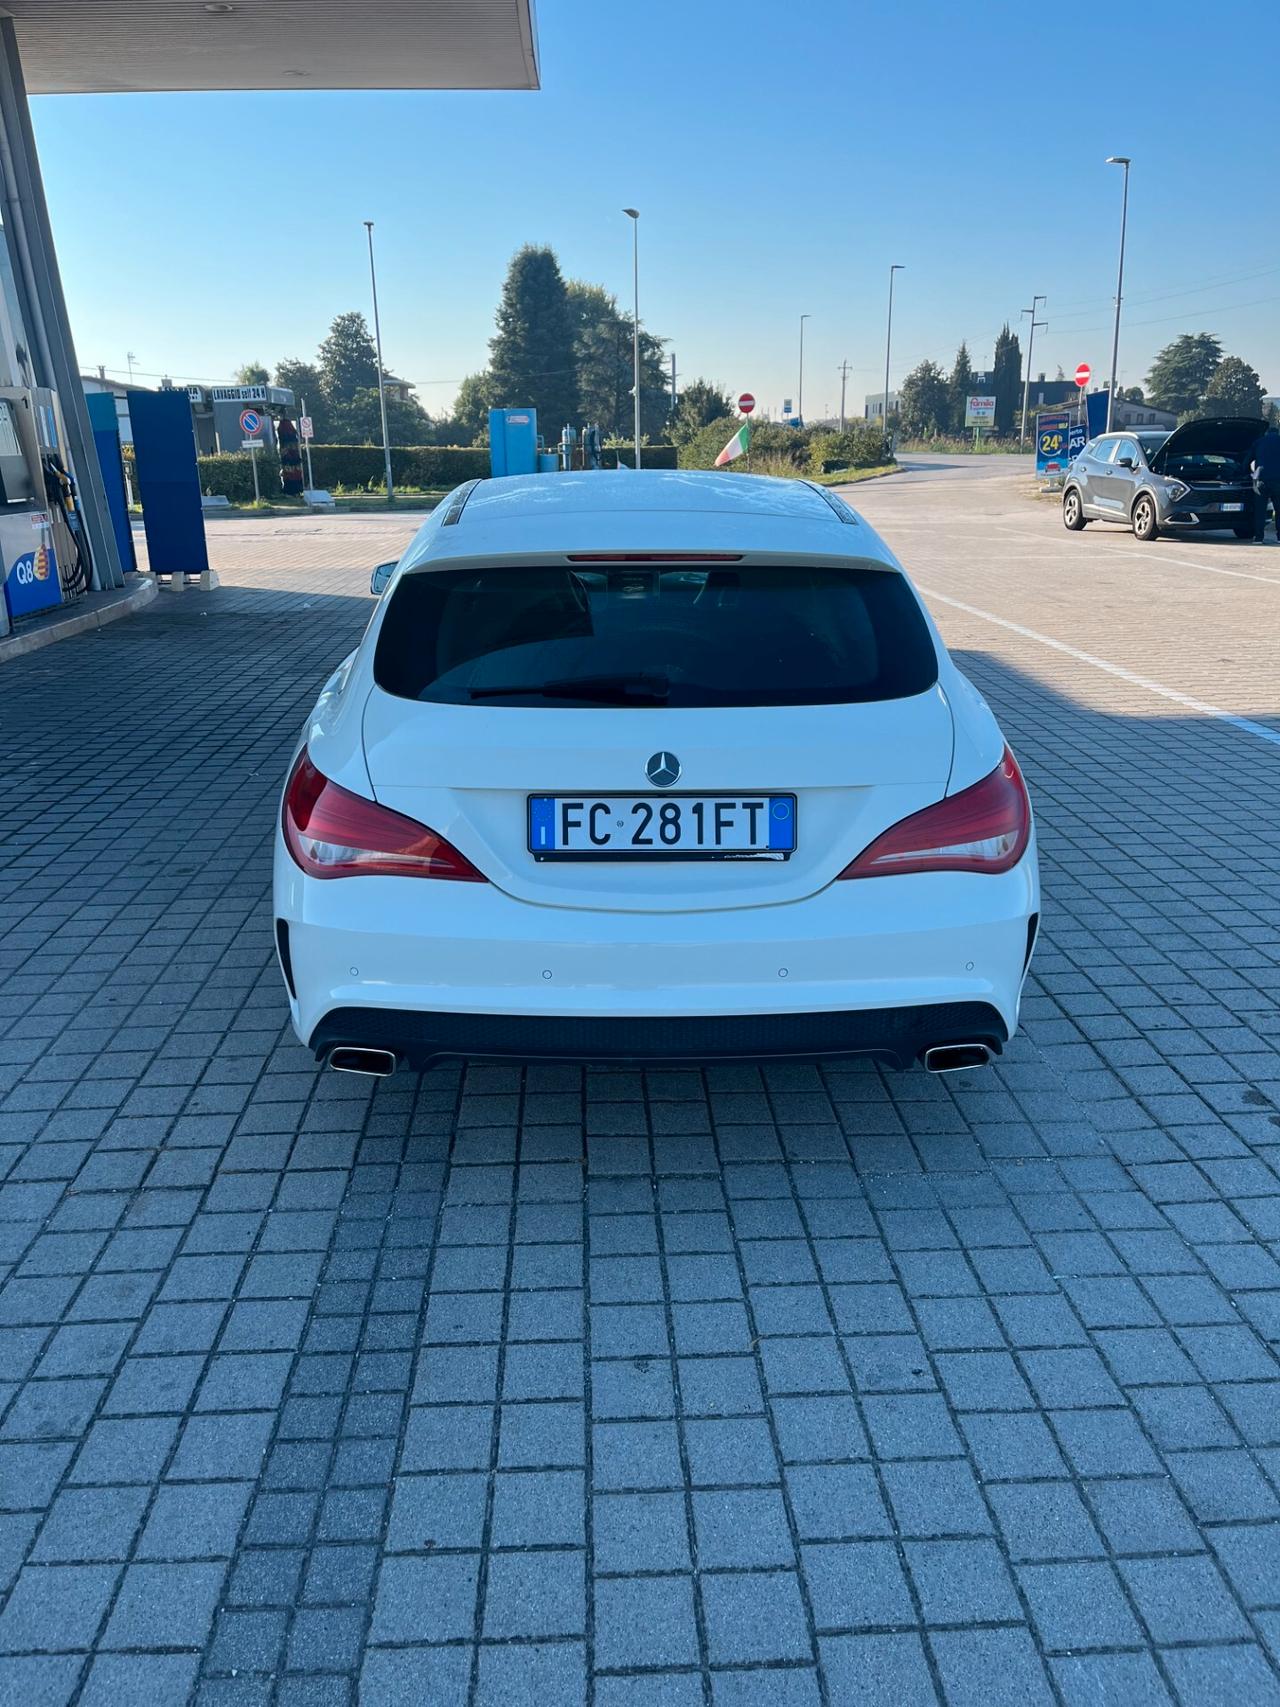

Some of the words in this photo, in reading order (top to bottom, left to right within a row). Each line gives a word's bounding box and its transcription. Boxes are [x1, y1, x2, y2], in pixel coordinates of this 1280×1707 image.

[1069, 436, 1086, 449] AR
[16, 560, 34, 585] Q8
[561, 802, 612, 846] FC
[631, 802, 764, 846] 281FT
